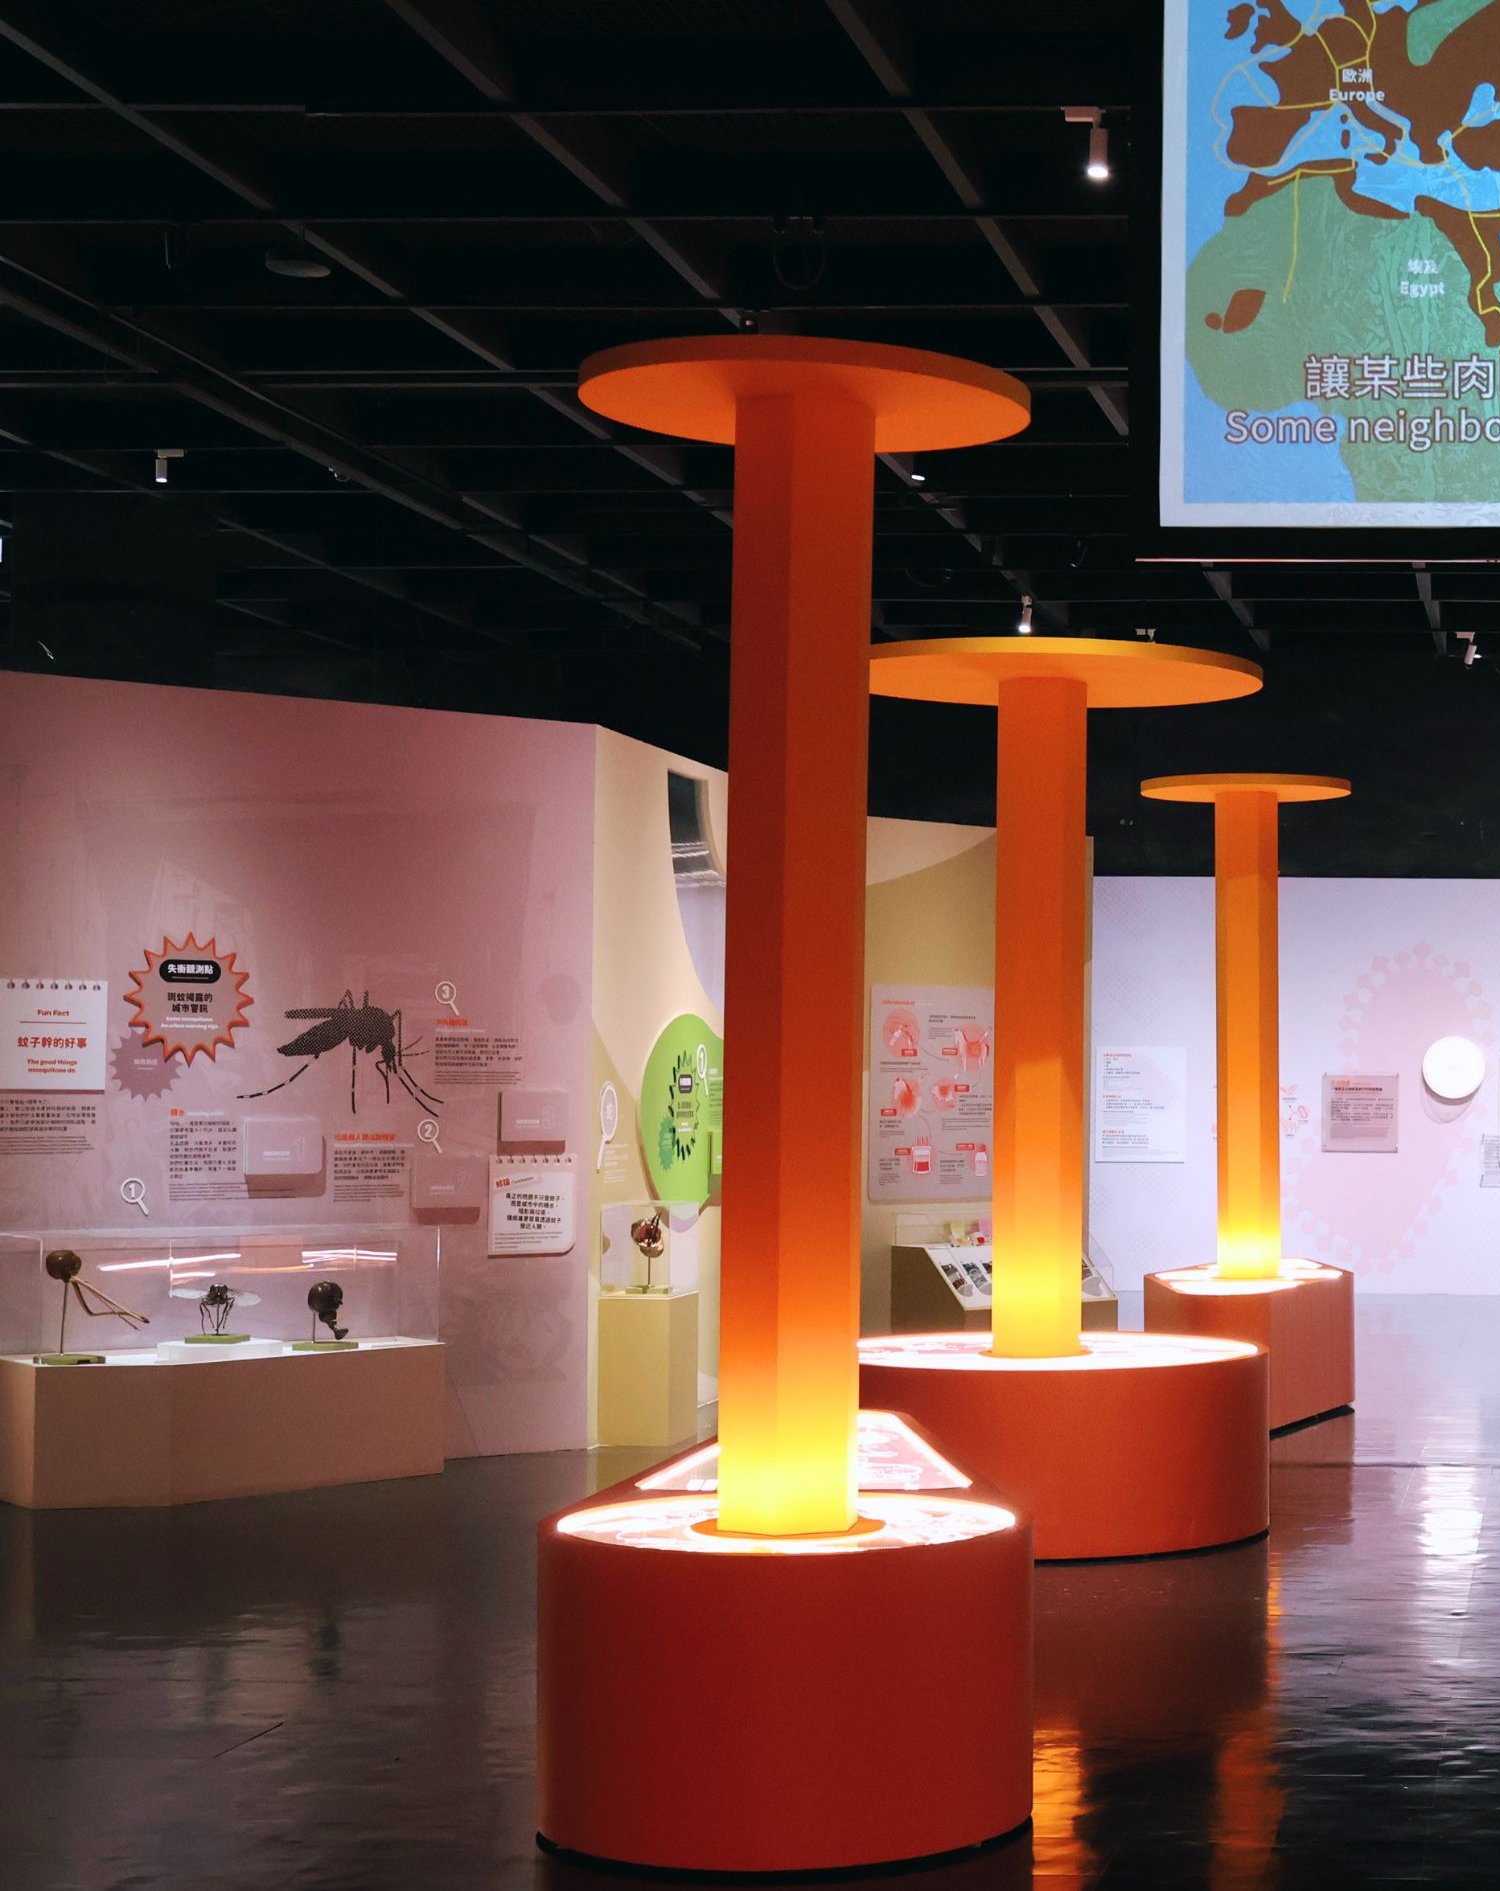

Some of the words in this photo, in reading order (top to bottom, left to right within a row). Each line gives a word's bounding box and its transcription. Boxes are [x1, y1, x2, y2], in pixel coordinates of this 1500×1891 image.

[1341, 68, 1374, 83] 歐洲
[1328, 89, 1386, 103] Europe
[1408, 259, 1439, 274] 埃及
[1400, 281, 1445, 298] Egypt
[1224, 410, 1337, 444] Some
[442, 985, 450, 999] 3
[37, 1009, 52, 1017] Fun
[53, 1009, 70, 1017] Fact
[17, 1036, 88, 1049] 蚊子幹的好事
[424, 1123, 433, 1138] 2
[128, 1183, 136, 1198] 1
